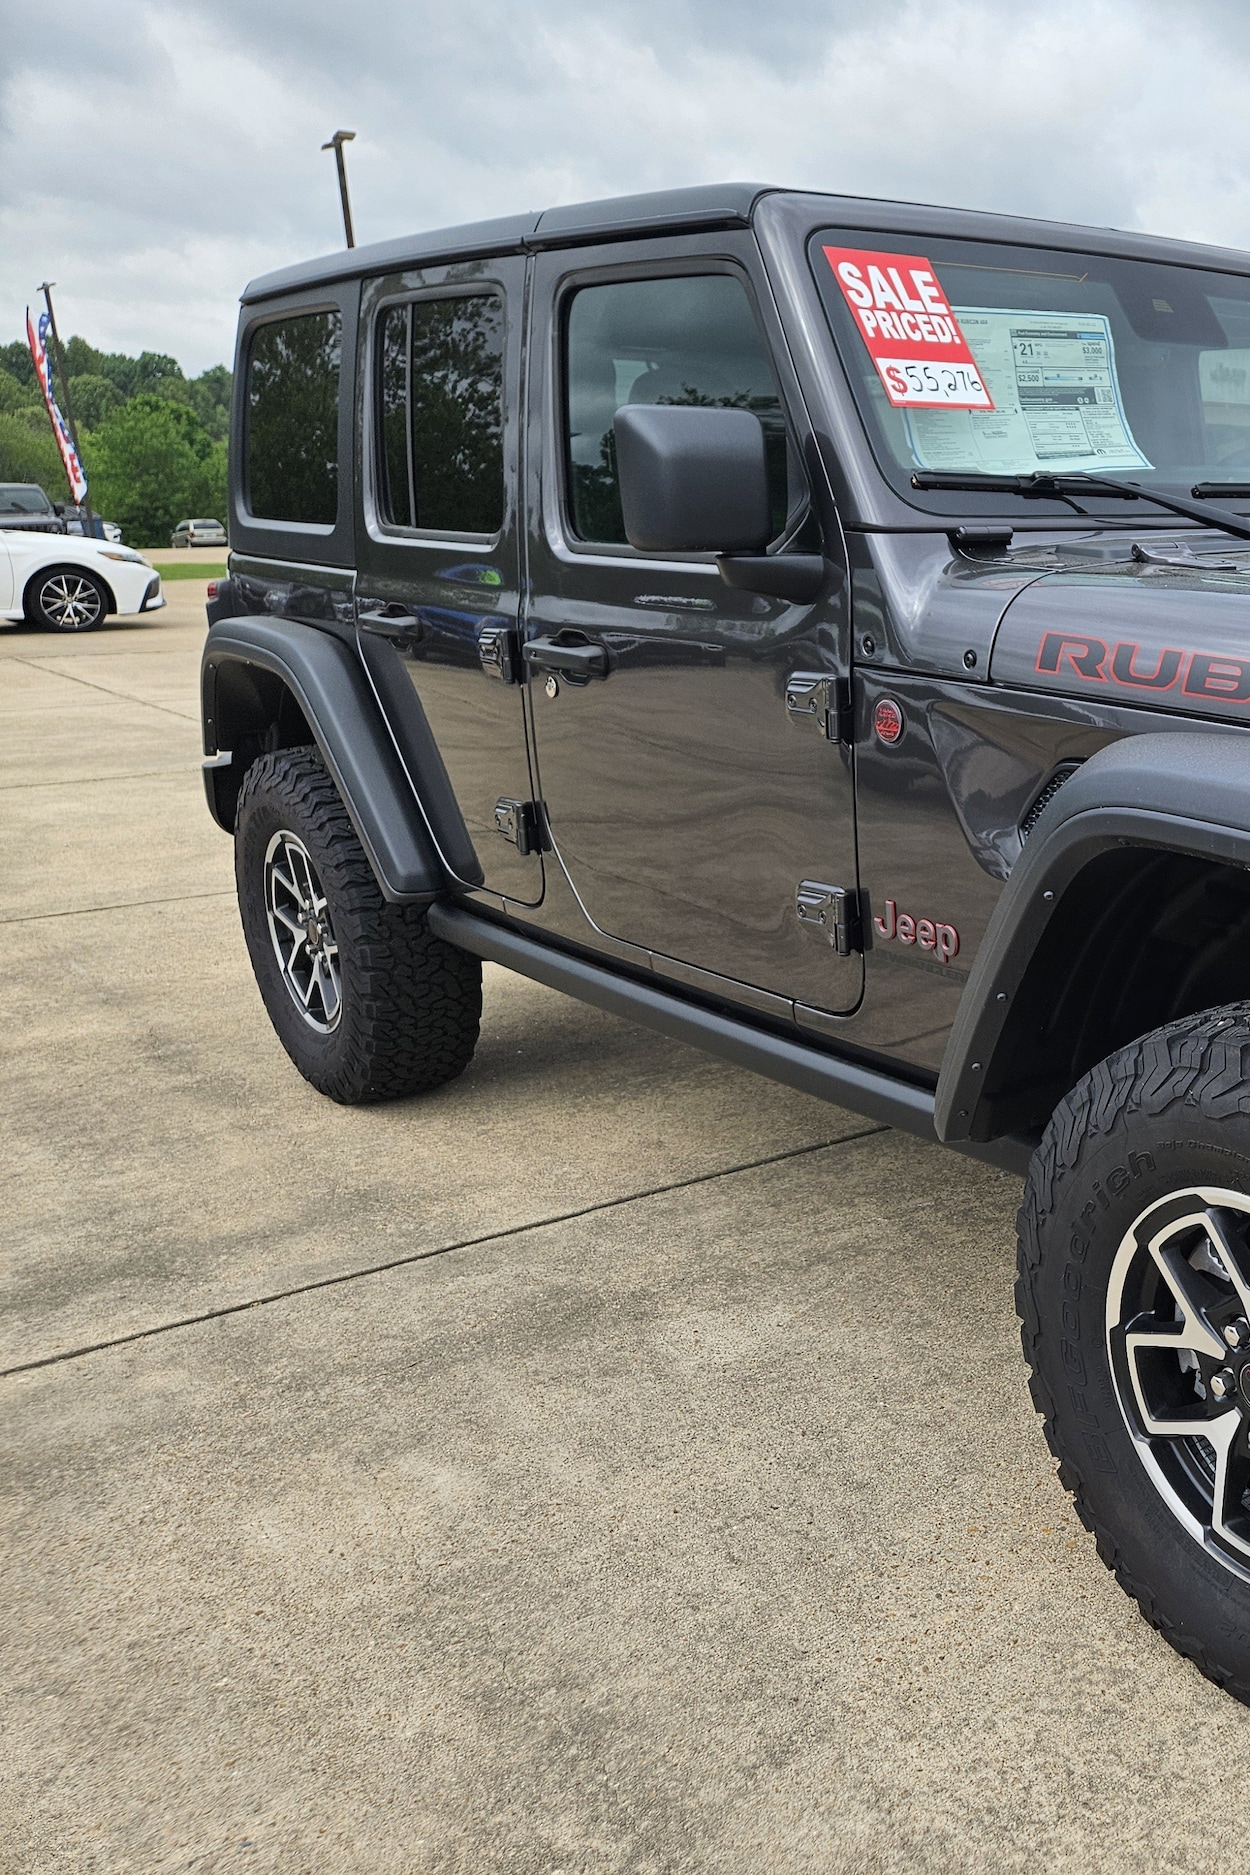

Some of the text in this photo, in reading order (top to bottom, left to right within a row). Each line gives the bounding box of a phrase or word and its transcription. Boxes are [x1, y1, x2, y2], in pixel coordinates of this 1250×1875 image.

[837, 261, 949, 315] SALE
[858, 308, 962, 345] PRICED!
[1019, 342, 1034, 356] 21
[1082, 346, 1103, 354] $3,000
[885, 365, 983, 399] $55,276
[1018, 374, 1040, 382] $2,500
[873, 899, 960, 963] Jeep
[1059, 1149, 1157, 1474] BFGoodrich
